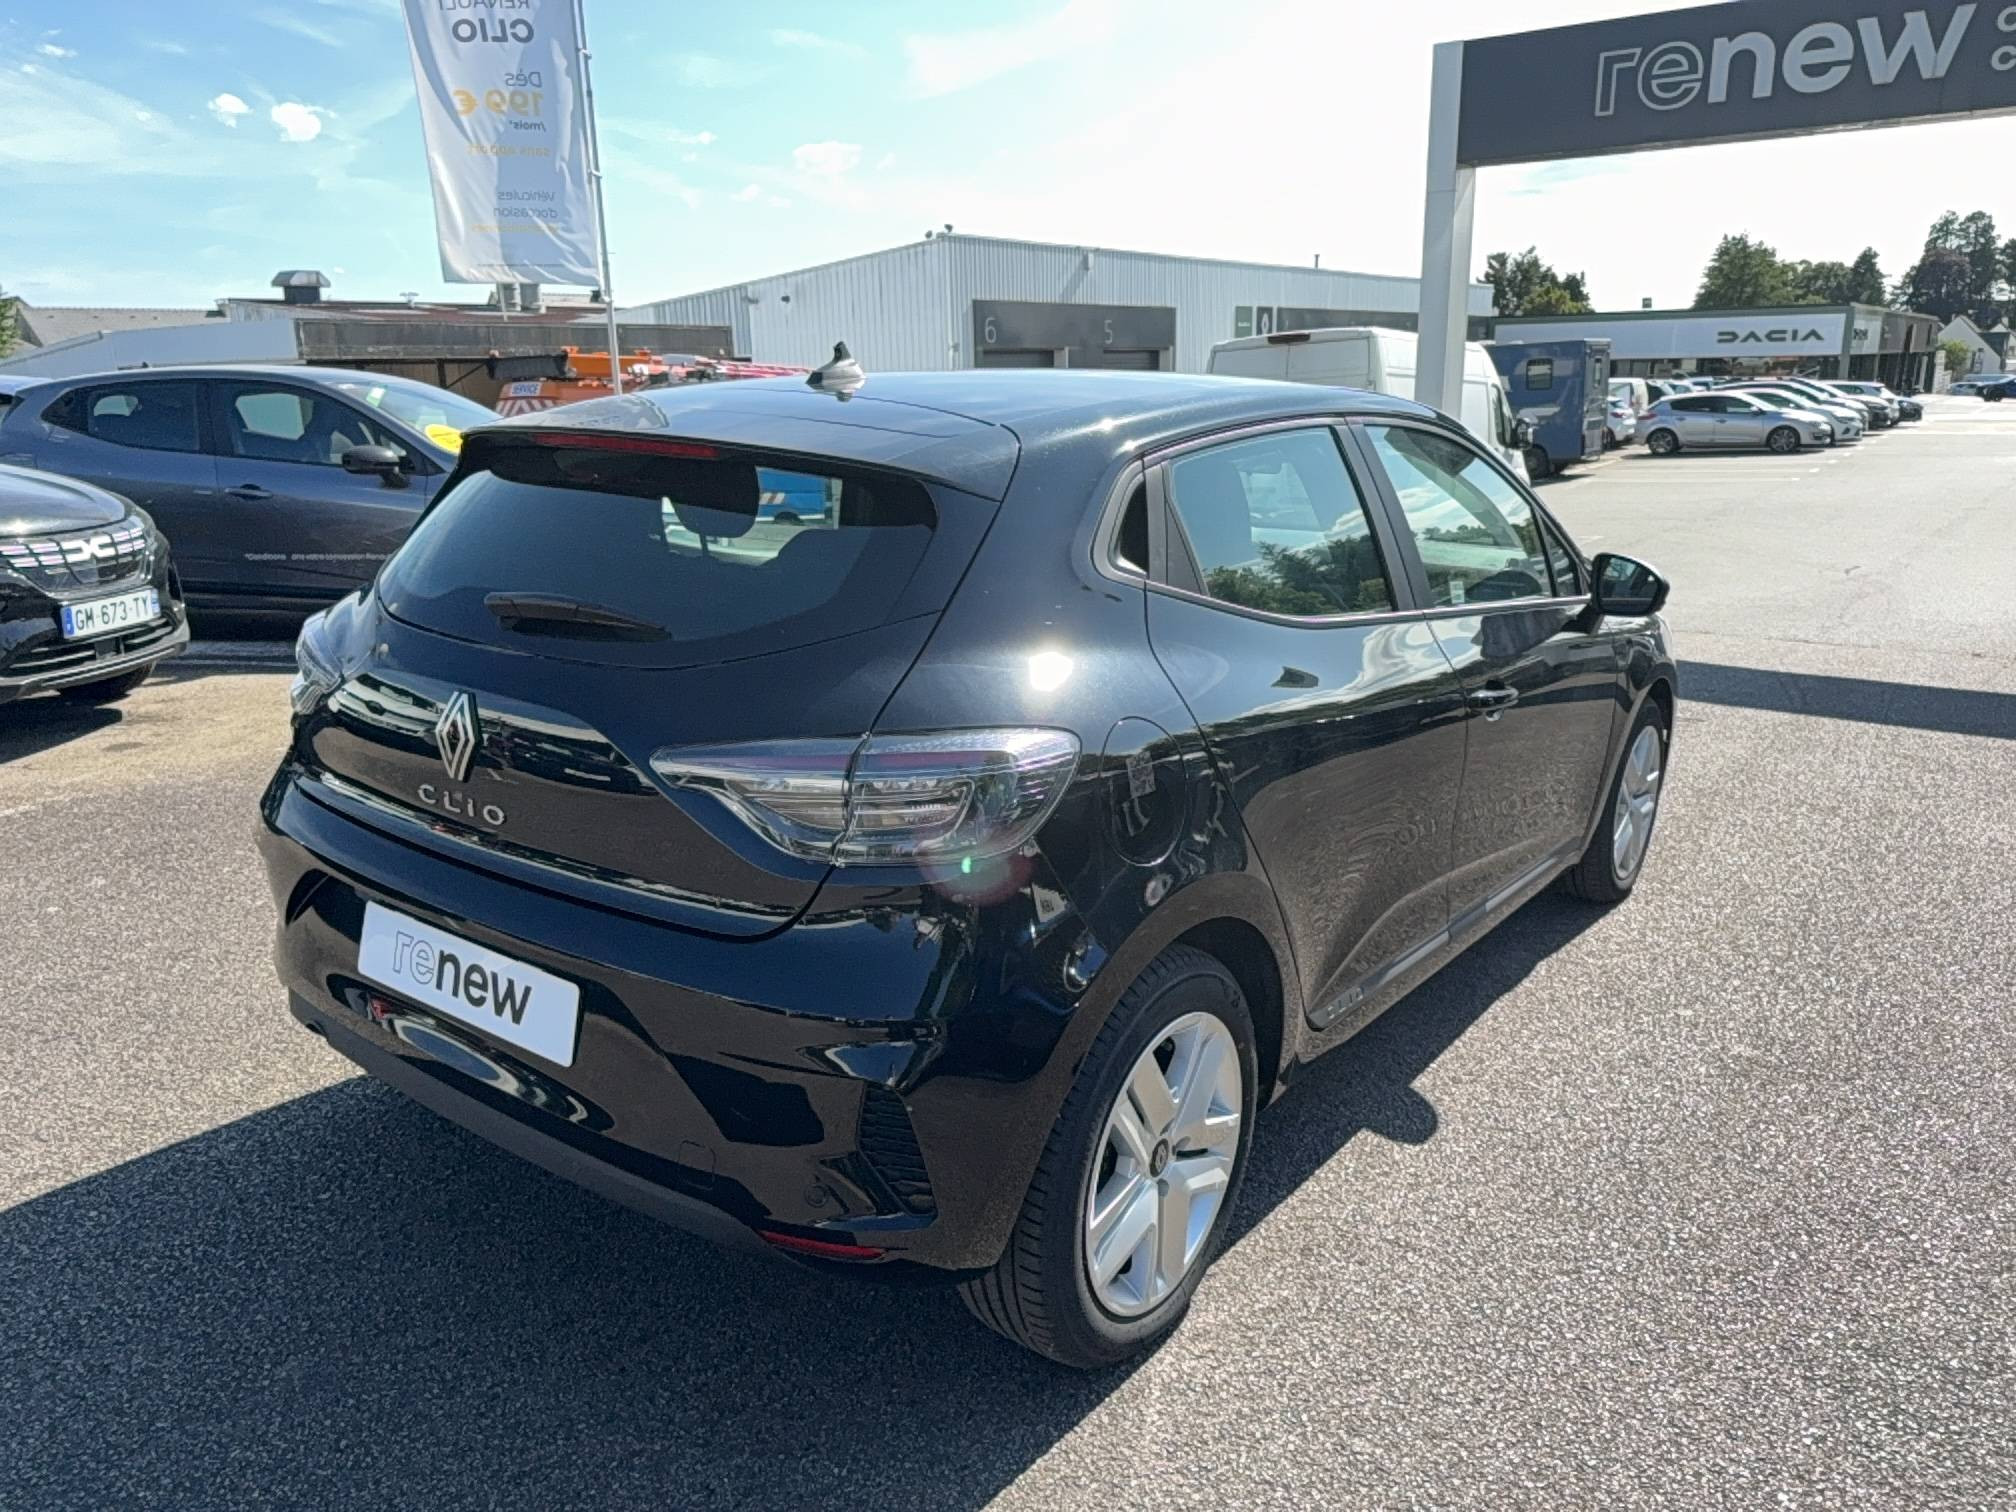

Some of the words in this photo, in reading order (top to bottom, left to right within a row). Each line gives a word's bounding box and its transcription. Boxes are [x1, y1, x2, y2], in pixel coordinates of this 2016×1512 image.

[1595, 3, 1977, 117] renew
[984, 316, 997, 343] 6
[1103, 319, 1113, 344] 5
[1717, 328, 1824, 343] DACIA
[418, 783, 505, 826] CLIO
[393, 931, 532, 1025] renew
